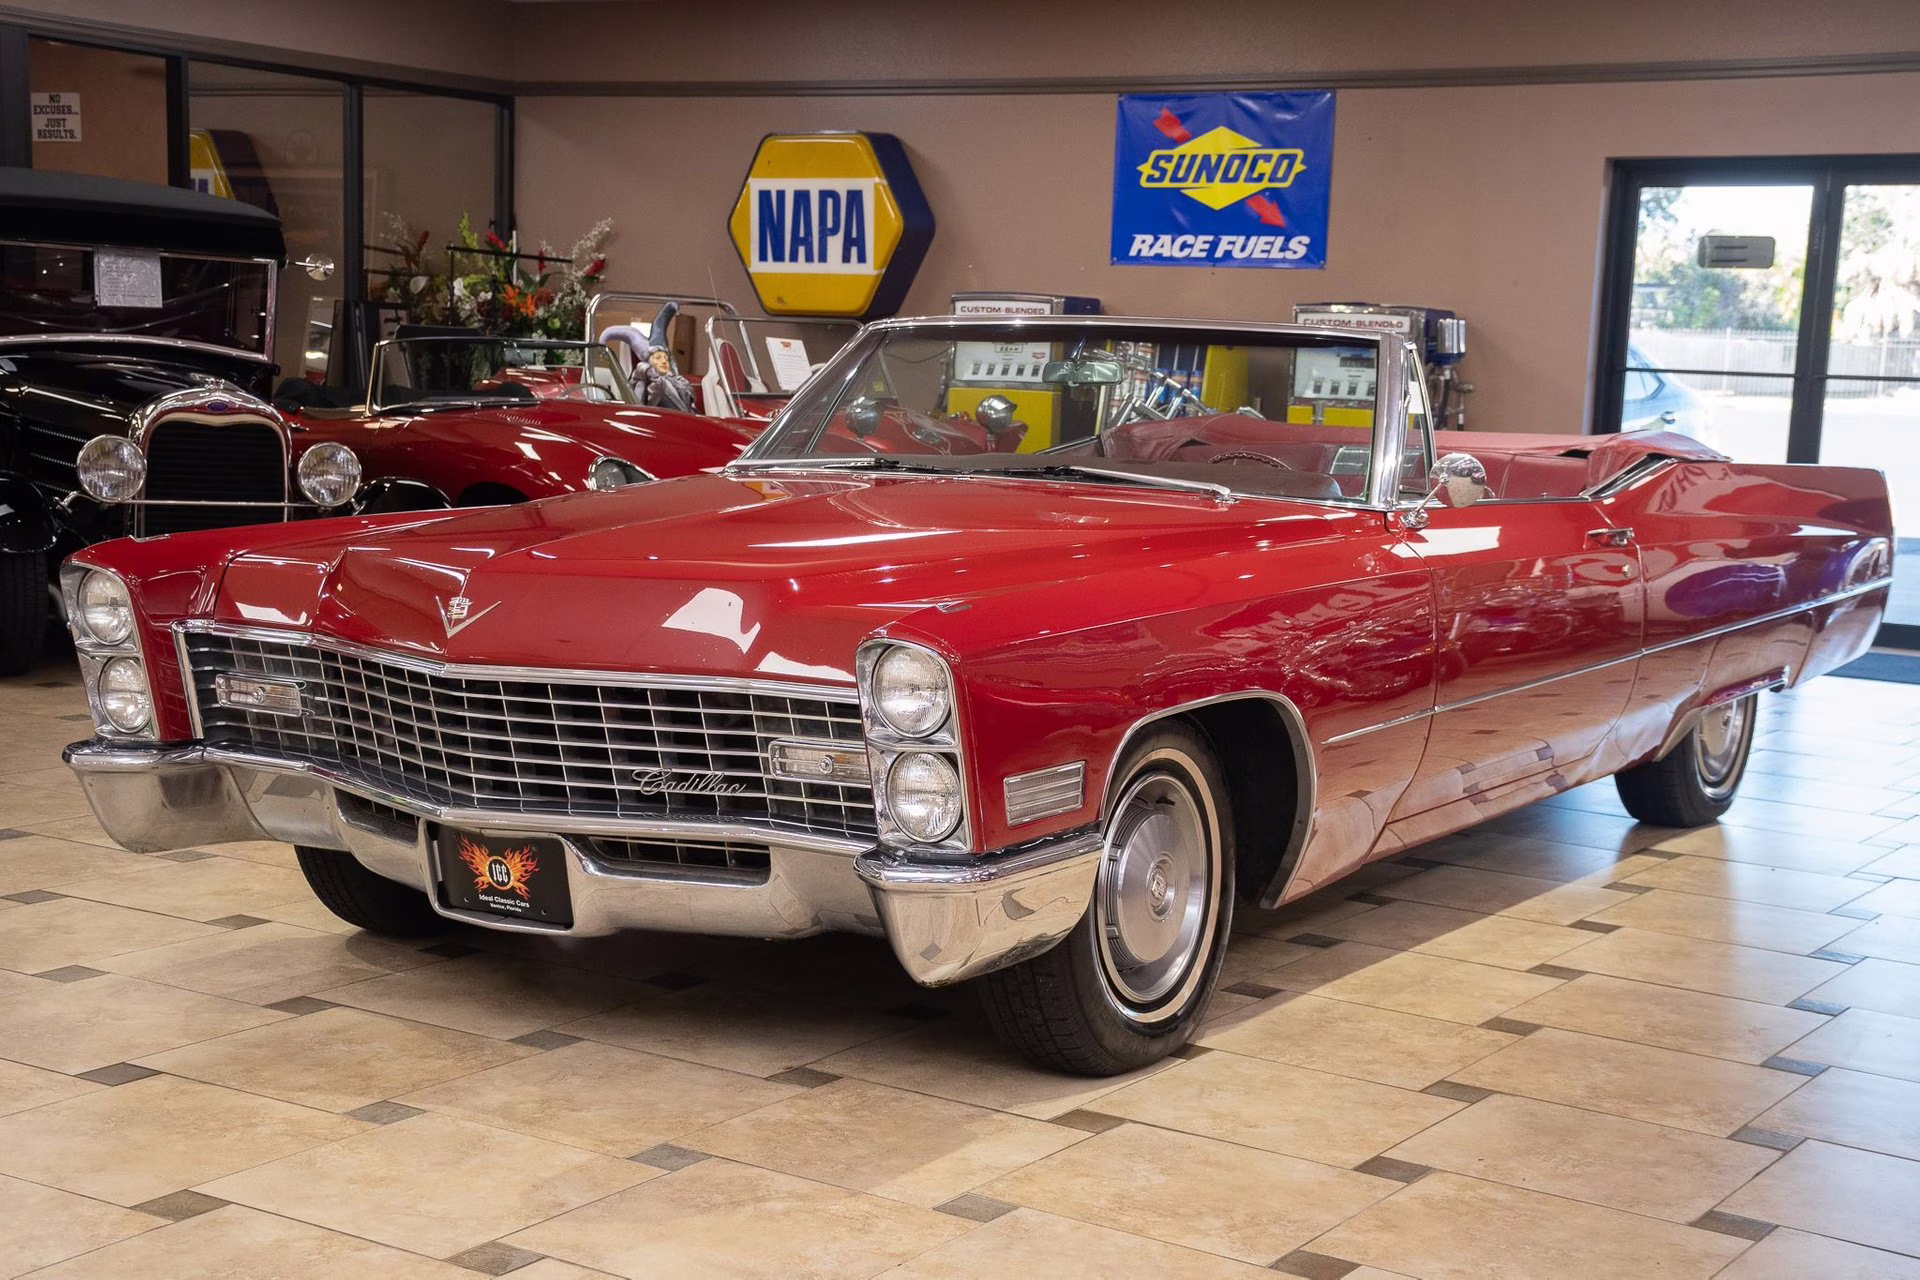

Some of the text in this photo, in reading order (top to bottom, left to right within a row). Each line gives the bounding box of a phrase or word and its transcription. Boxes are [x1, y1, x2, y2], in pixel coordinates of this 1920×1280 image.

[49, 94, 61, 104] NO
[45, 118, 67, 128] JUST
[37, 129, 78, 140] RESULTS.
[1145, 153, 1299, 184] SUNOCO
[758, 189, 867, 264] NAPA
[1128, 233, 1311, 260] RACE FUELS
[631, 768, 747, 796] Cadillac
[492, 863, 508, 883] ICC
[494, 896, 515, 905] Classic
